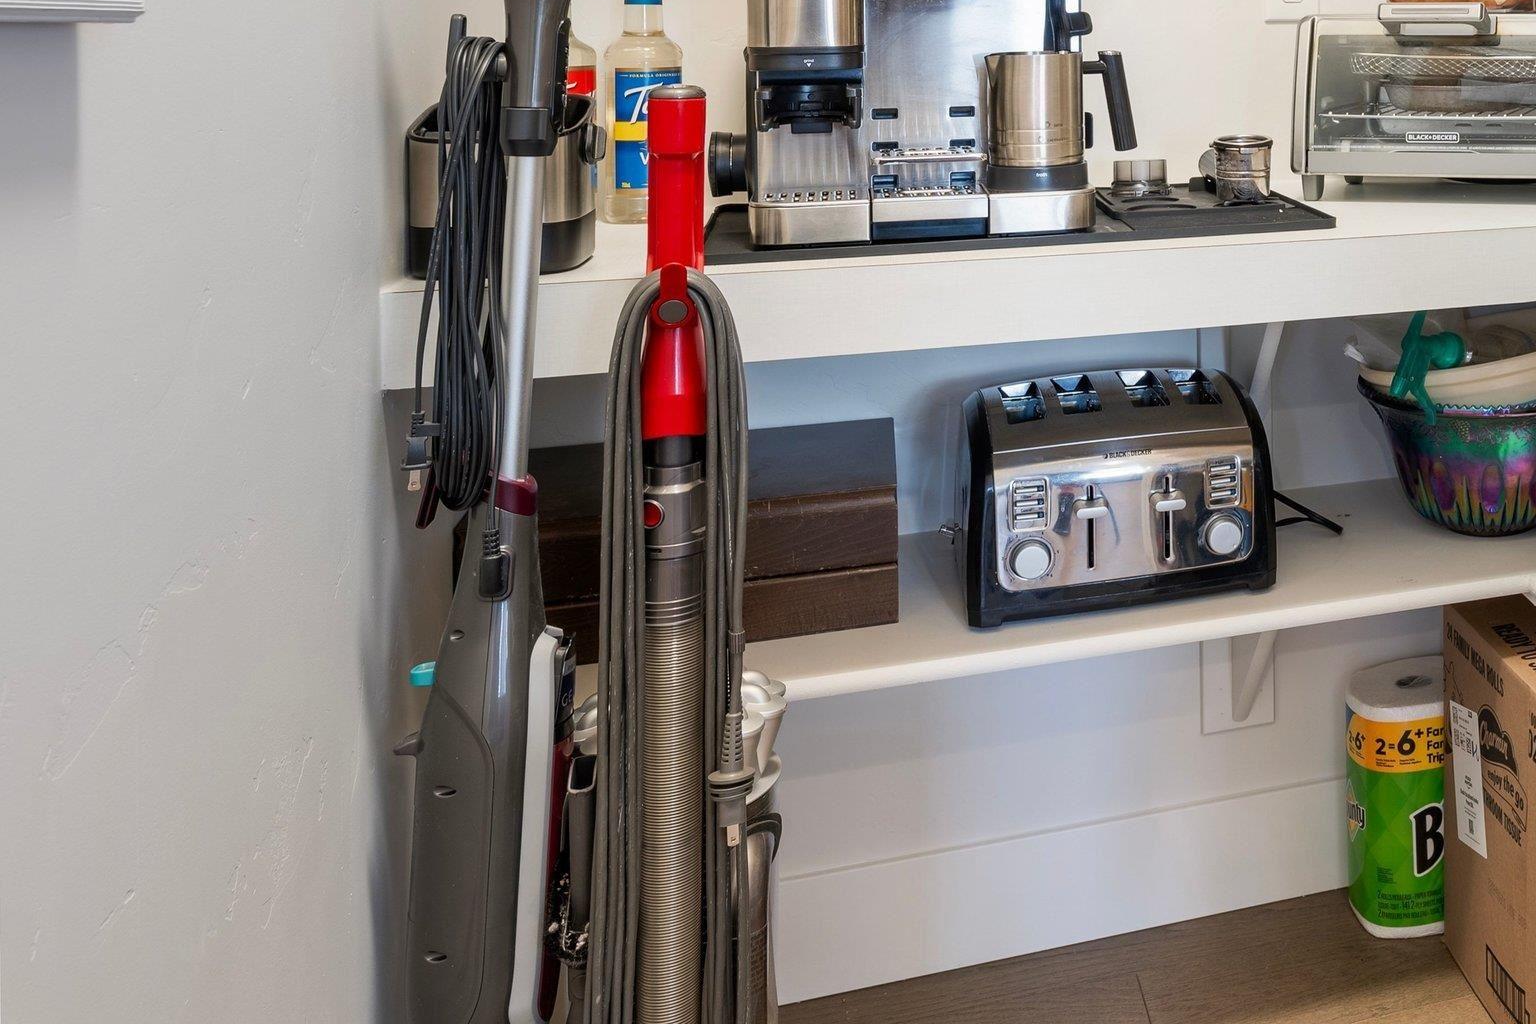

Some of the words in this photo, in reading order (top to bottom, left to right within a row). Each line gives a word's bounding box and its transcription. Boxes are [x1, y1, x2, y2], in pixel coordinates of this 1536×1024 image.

[1491, 622, 1535, 648] READY
[1487, 768, 1503, 791] enjoy
[1503, 778, 1515, 797] the
[1515, 791, 1525, 811] go
